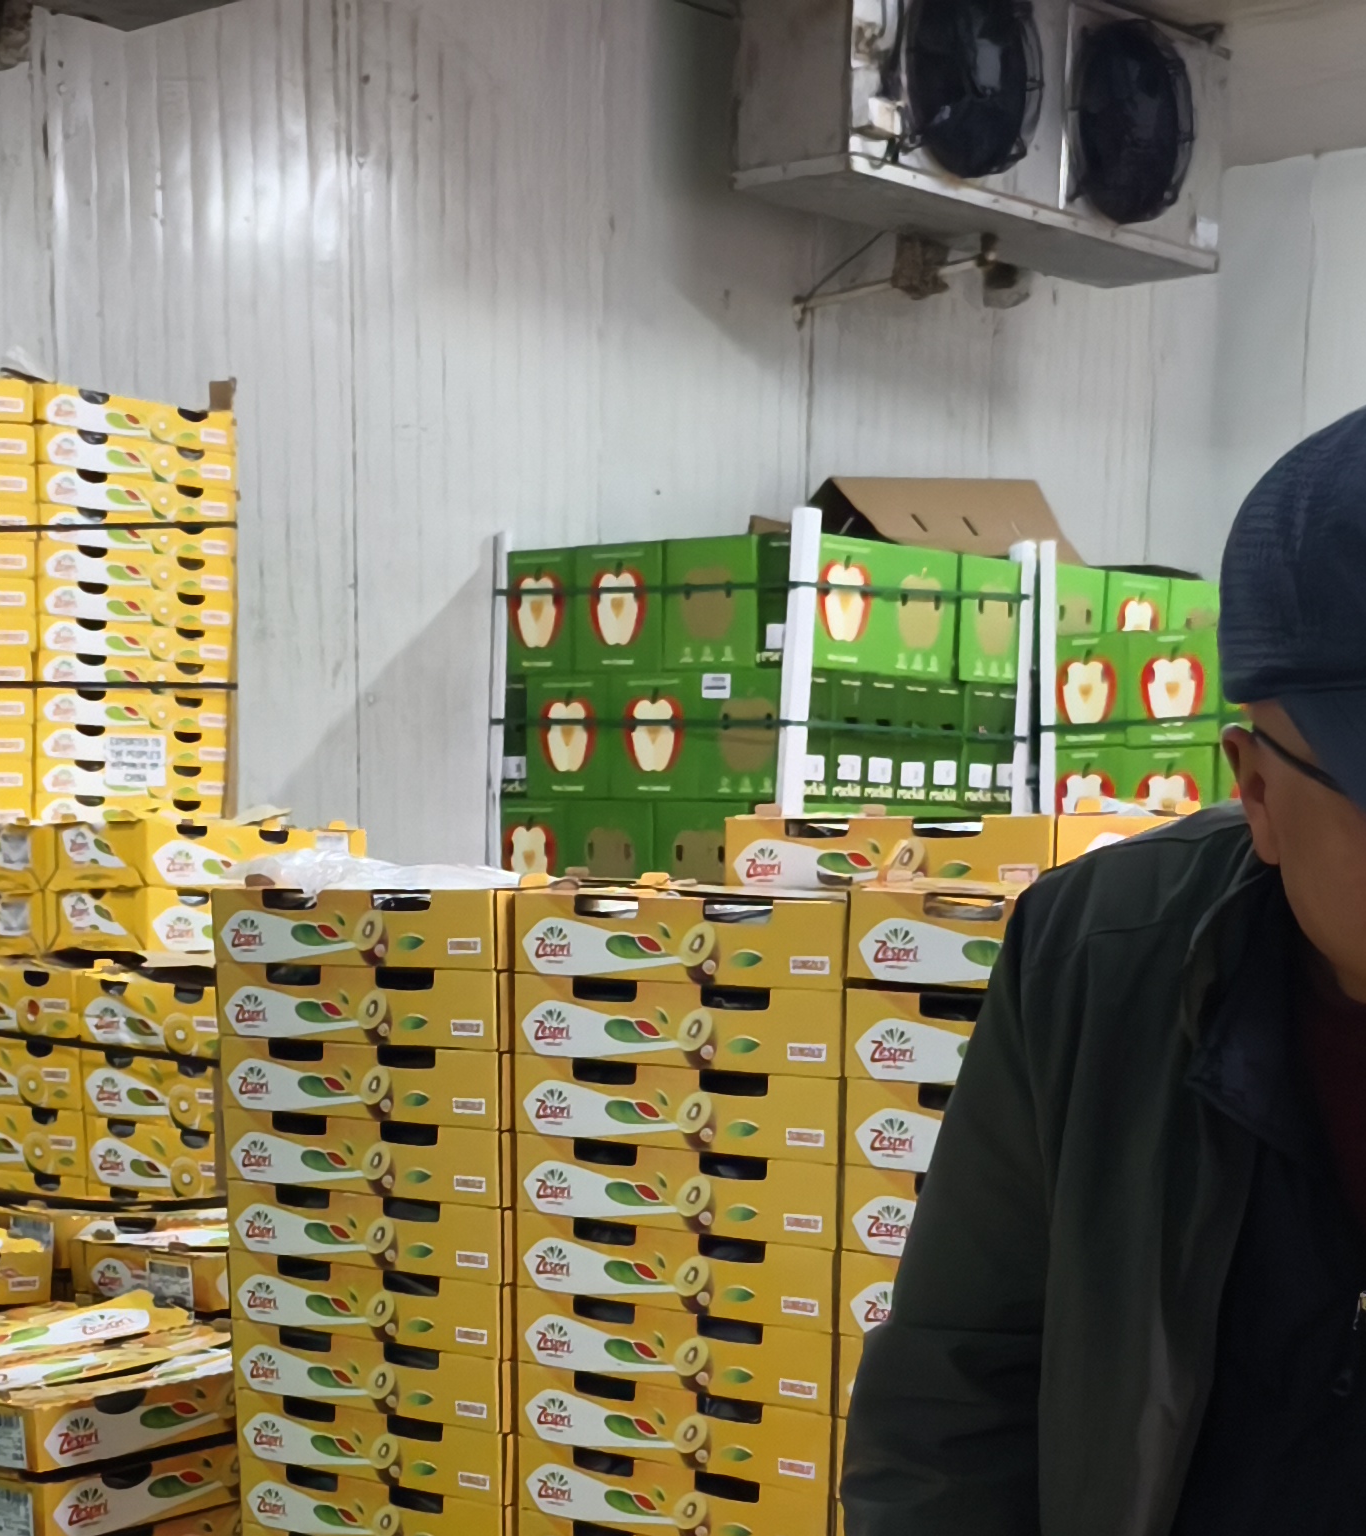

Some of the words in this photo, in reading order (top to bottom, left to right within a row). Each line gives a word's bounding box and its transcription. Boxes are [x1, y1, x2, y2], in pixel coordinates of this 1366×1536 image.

[746, 859, 781, 879] Zespri
[874, 940, 920, 962] Zespri
[871, 1040, 916, 1062] Zespri
[870, 1129, 915, 1151] Zespri
[58, 1431, 99, 1455] Zespri
[67, 1502, 108, 1526] Zespri
